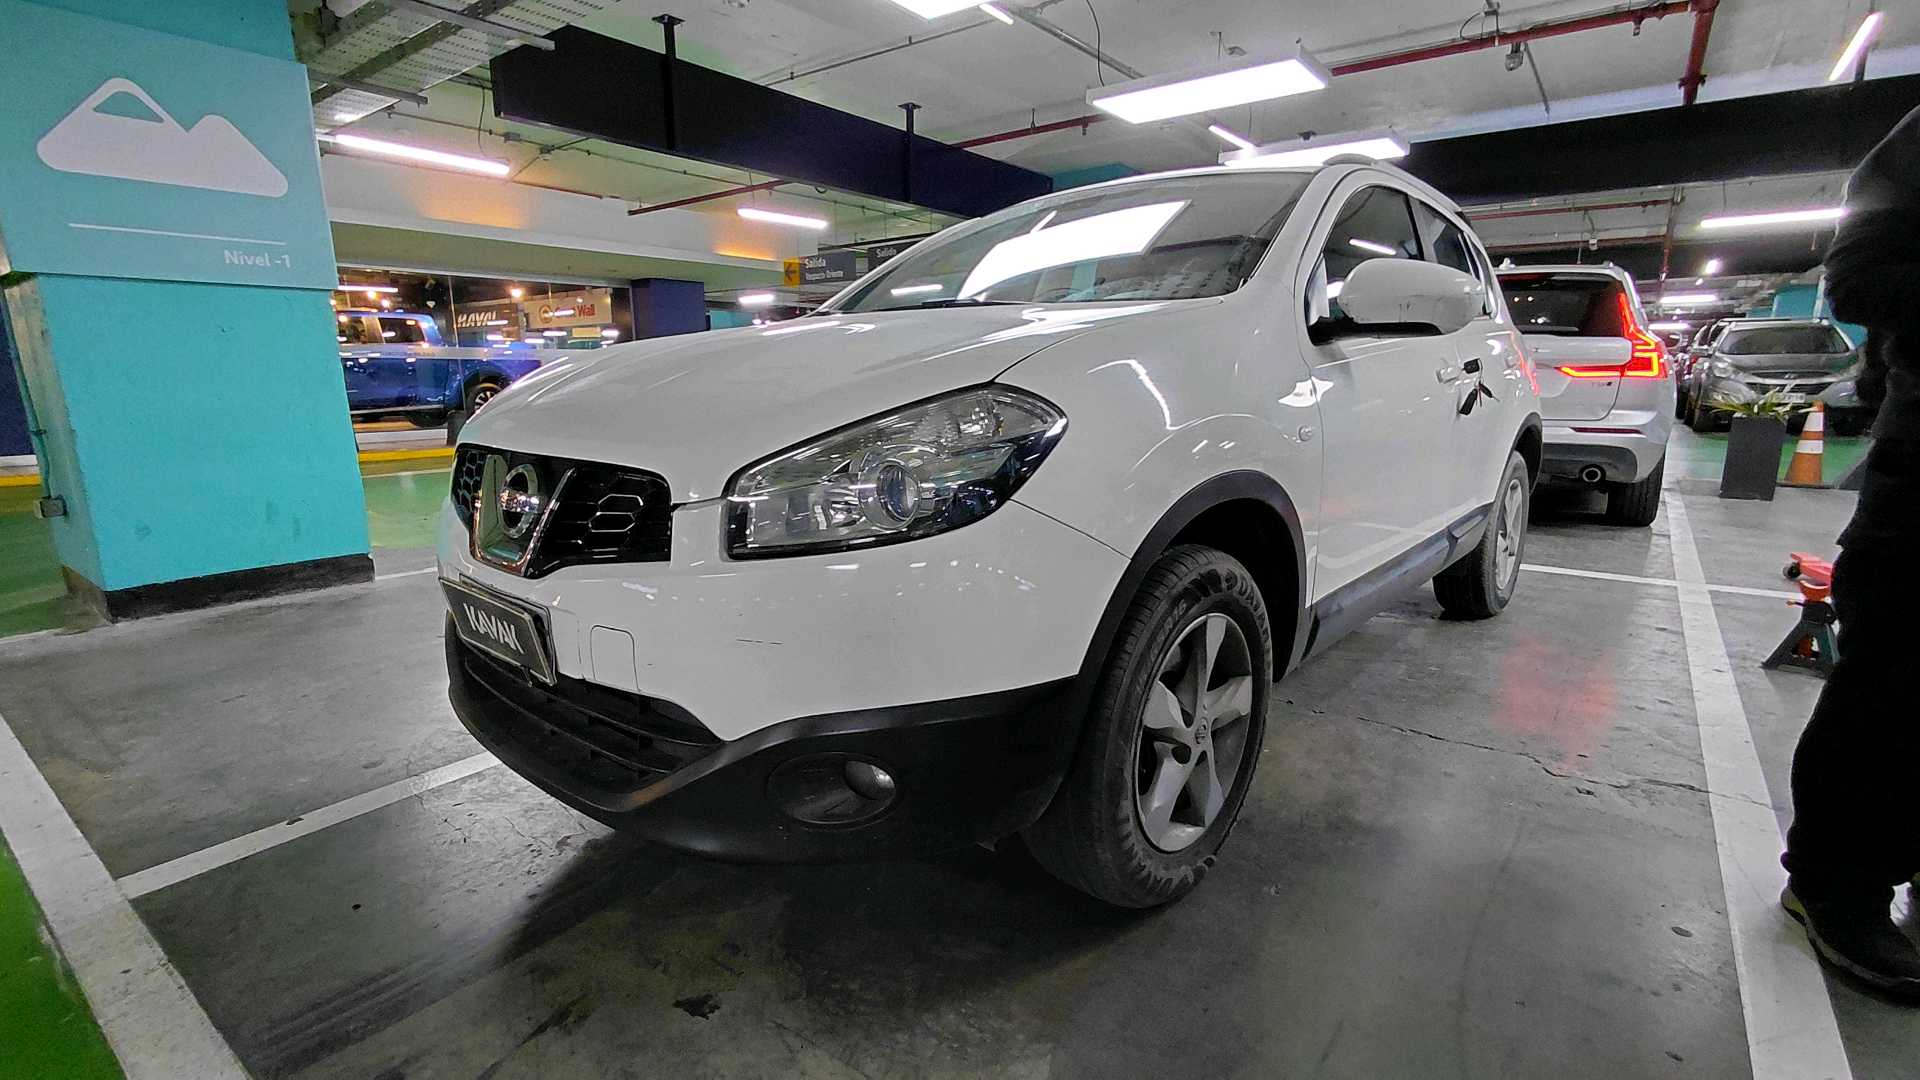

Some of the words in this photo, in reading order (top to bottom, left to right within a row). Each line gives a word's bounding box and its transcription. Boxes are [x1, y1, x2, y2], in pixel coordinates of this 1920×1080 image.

[224, 249, 271, 266] Nivel
[275, 254, 291, 268] -1
[876, 247, 897, 258] Salida
[576, 303, 596, 317] Wall
[463, 603, 525, 654] KAVAK
